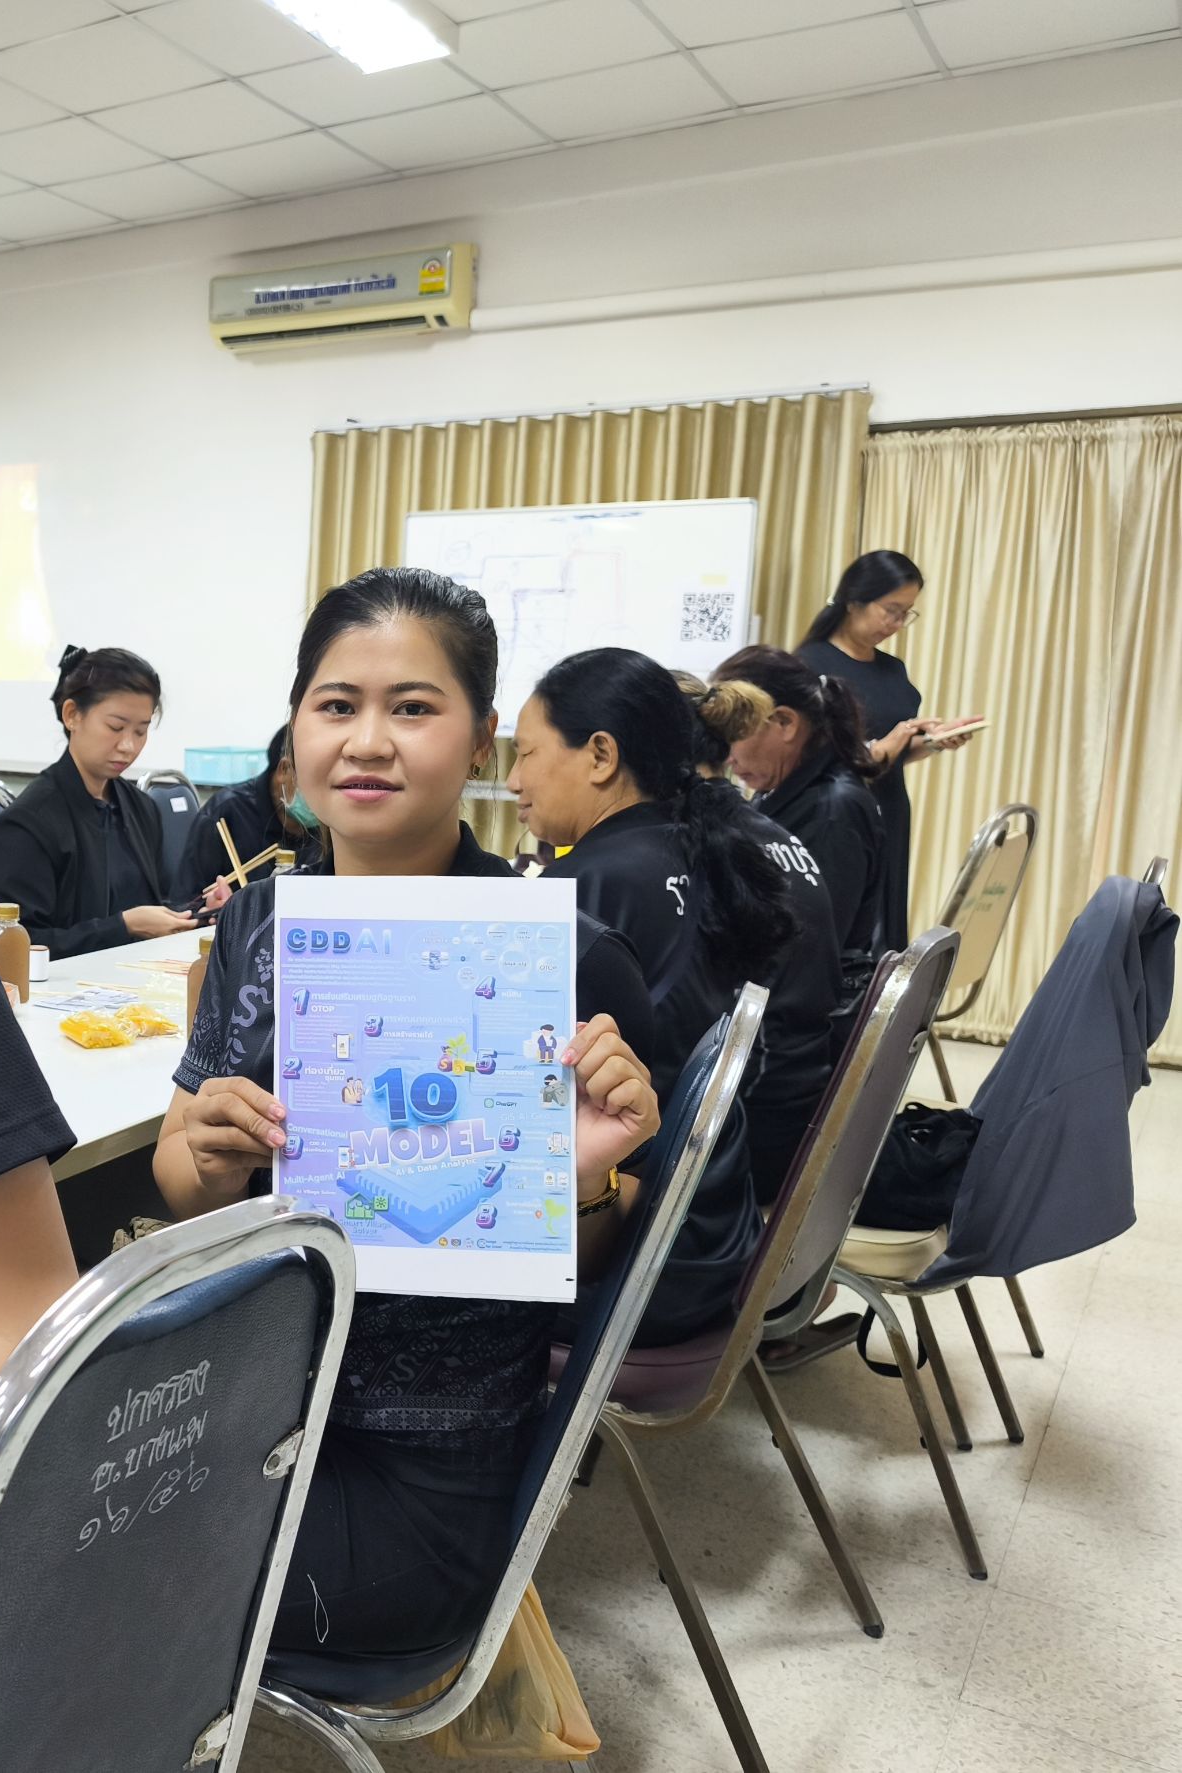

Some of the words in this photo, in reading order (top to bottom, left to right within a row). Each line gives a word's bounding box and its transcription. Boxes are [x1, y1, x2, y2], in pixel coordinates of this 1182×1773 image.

[287, 928, 351, 953] CDD
[356, 928, 392, 954] AI
[475, 975, 497, 999] 4
[293, 986, 310, 1016] 1
[311, 1005, 335, 1013] OTOP
[364, 1014, 383, 1038] 3
[282, 1056, 303, 1080] 2
[475, 1048, 498, 1075] 5
[373, 1067, 458, 1123] 10
[287, 1123, 348, 1138] Conversational
[499, 1124, 521, 1151] 6
[349, 1118, 497, 1170] MODEL
[284, 1173, 334, 1185] Multi-Agent
[418, 1163, 438, 1173] Data
[482, 1161, 506, 1188] 7
[475, 1203, 498, 1230] 8
[107, 1359, 211, 1443] ปกครอง
